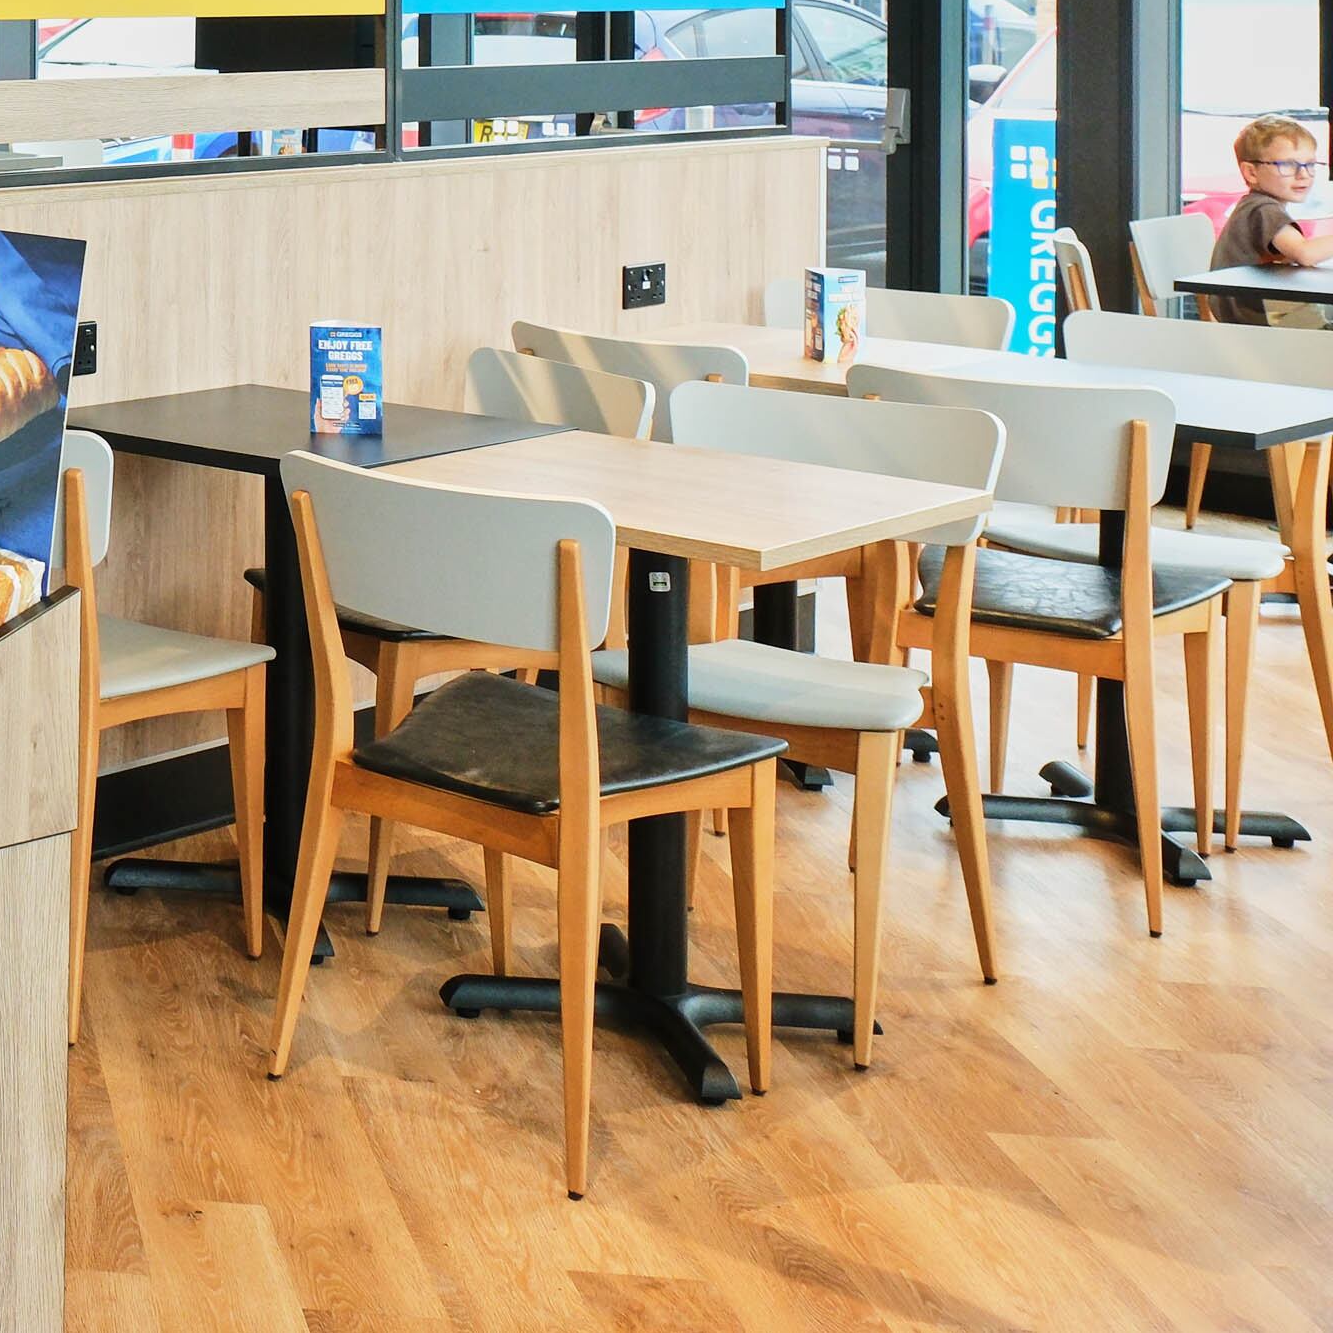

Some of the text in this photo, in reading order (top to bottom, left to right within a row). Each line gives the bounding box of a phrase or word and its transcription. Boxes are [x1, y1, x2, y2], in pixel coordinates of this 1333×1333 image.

[318, 340, 373, 350] ENJOY FREE
[328, 351, 363, 361] GREGGS
